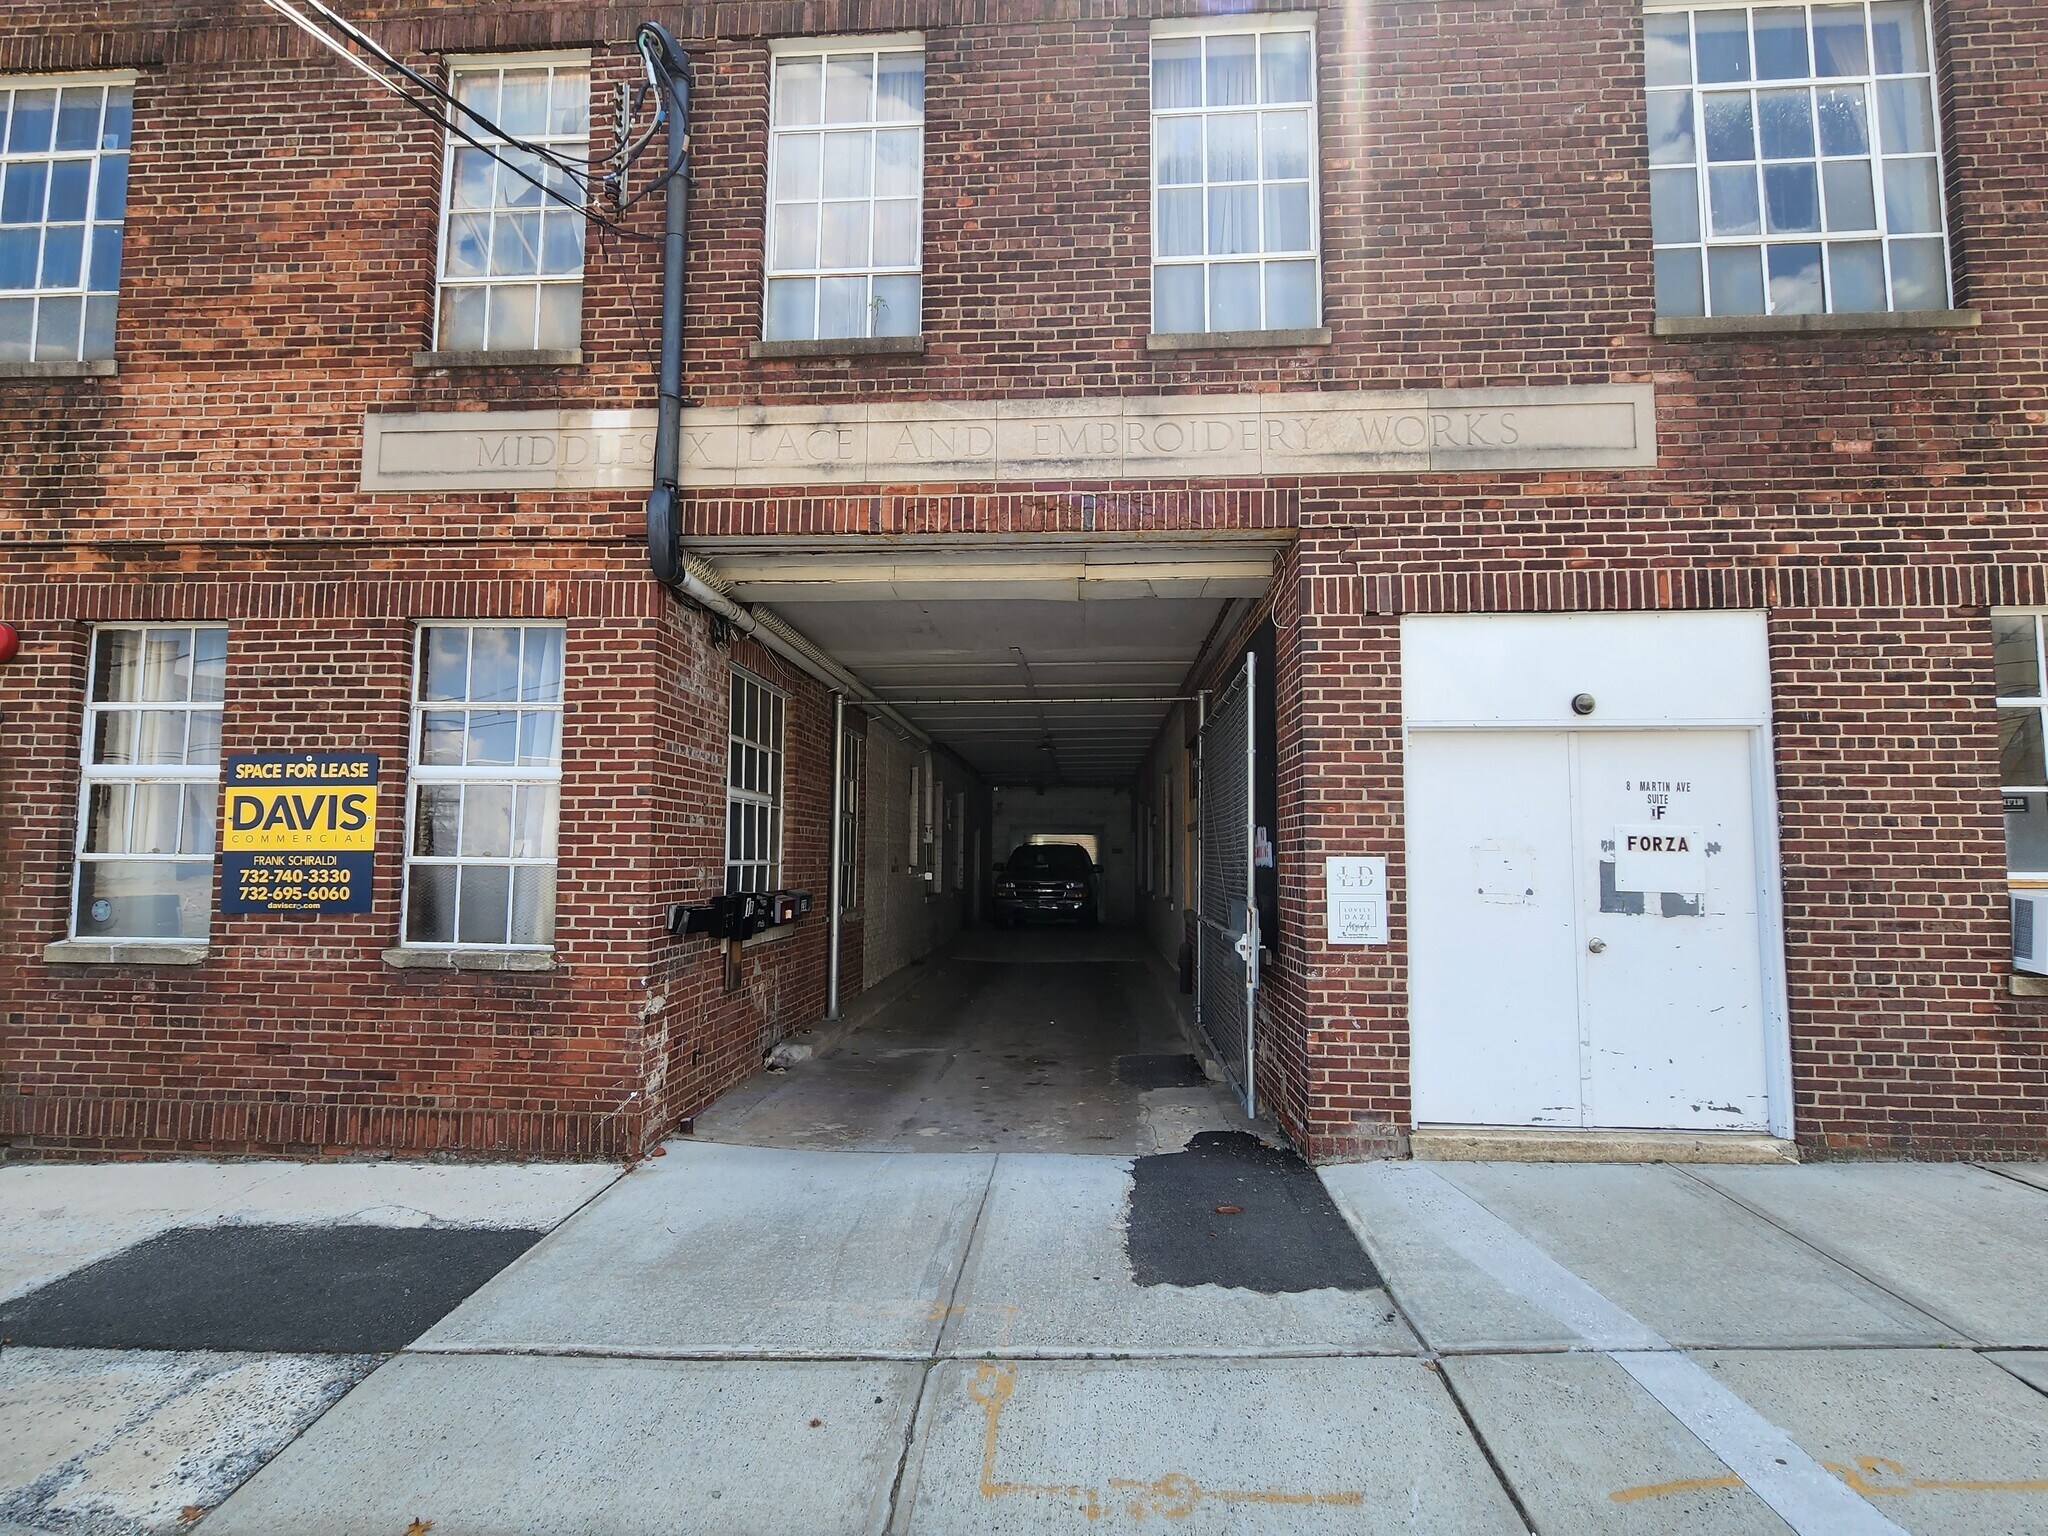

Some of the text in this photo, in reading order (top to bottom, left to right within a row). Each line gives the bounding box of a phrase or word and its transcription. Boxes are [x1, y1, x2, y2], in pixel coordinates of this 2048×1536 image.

[477, 412, 1519, 467] MIDDLESX LACE AND EMBROIDERY WORKS
[235, 762, 369, 779] SPACE FOR LEASE
[1626, 780, 1691, 792] 8 MARTIN AVE
[1647, 794, 1668, 804] SUITE
[232, 794, 368, 831] DAVIS
[232, 834, 366, 843] COMMERCIAL
[1627, 836, 1689, 851] FORZA
[253, 856, 337, 866] FRANK SCHIRALDI
[239, 869, 351, 884] 732-740-3330
[239, 886, 350, 900] 732-695-6060
